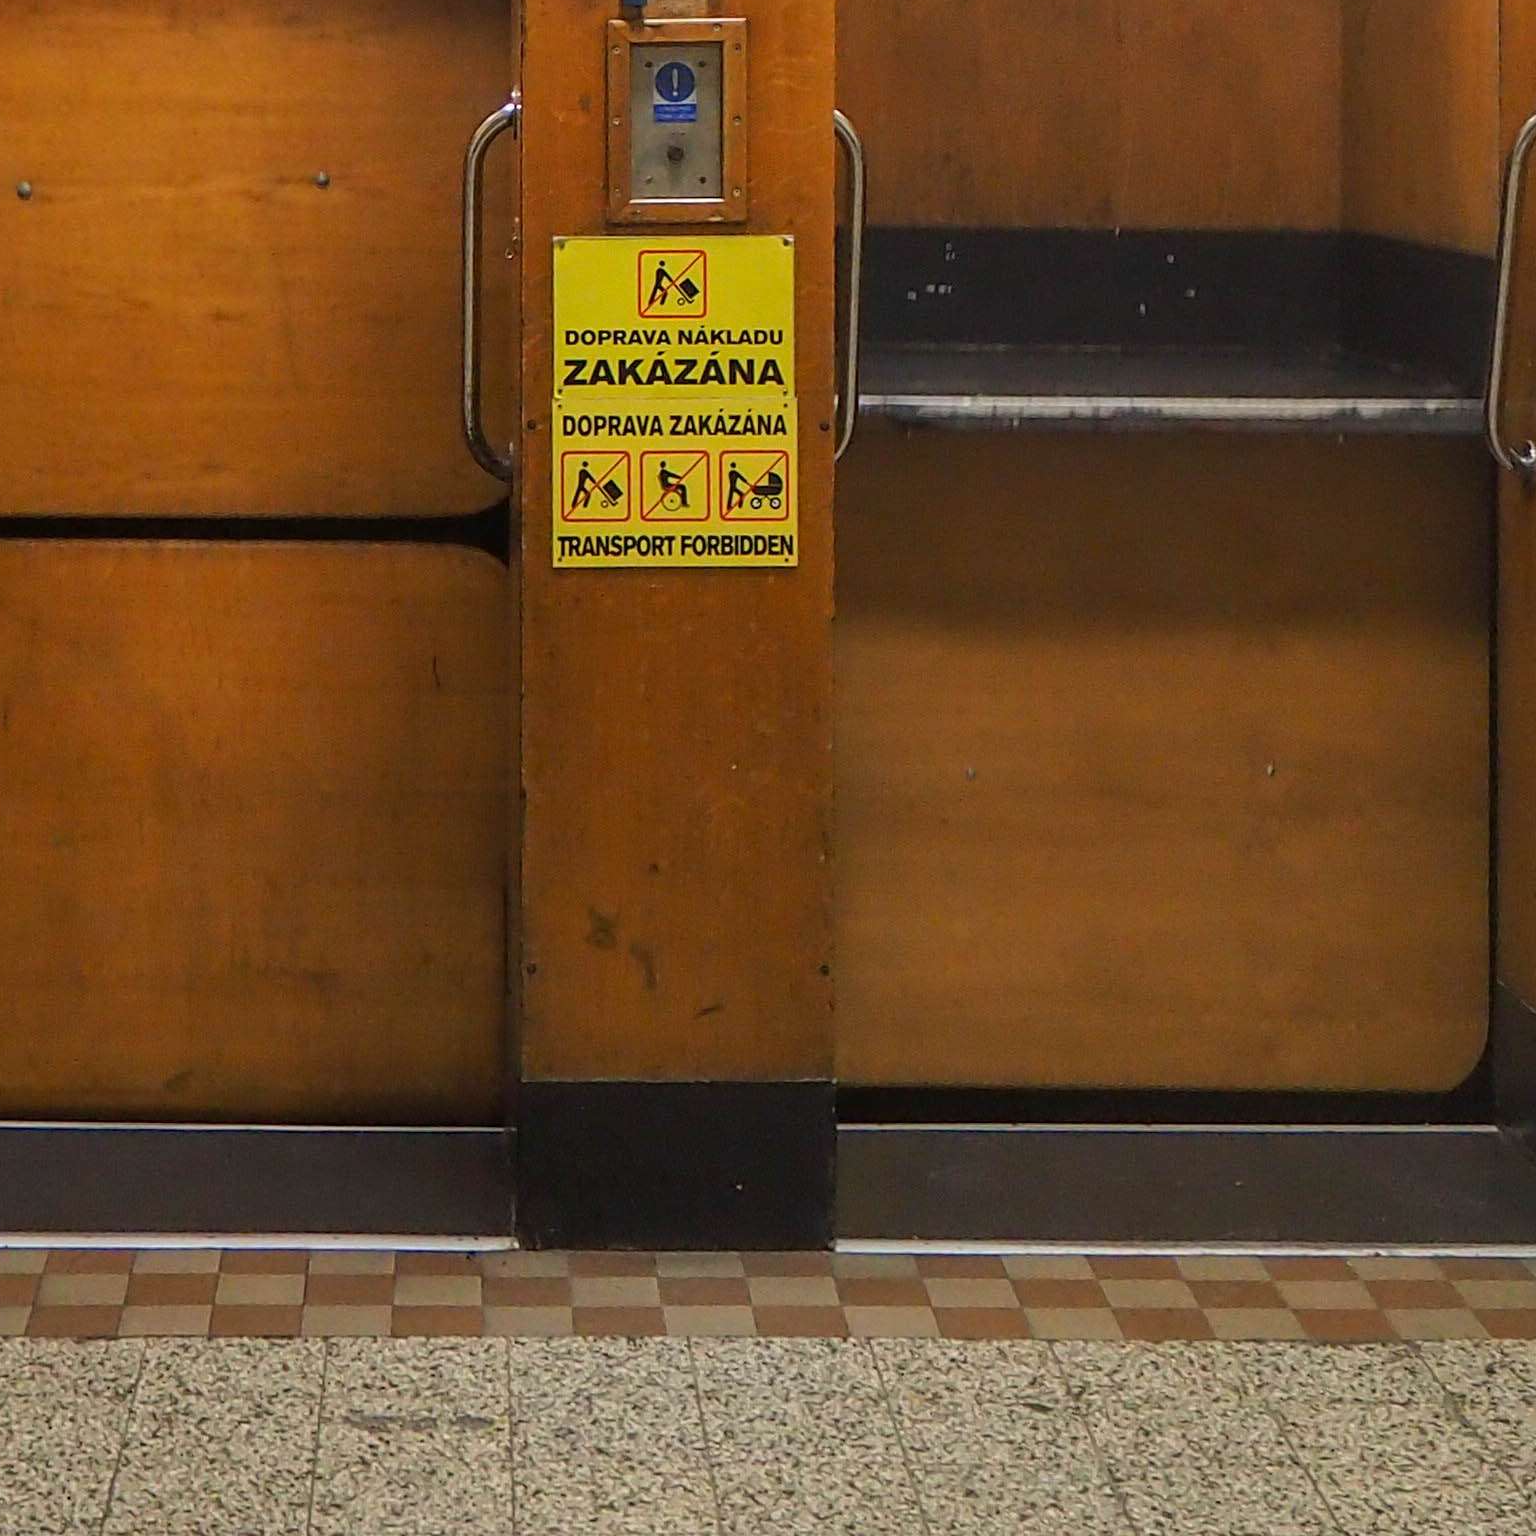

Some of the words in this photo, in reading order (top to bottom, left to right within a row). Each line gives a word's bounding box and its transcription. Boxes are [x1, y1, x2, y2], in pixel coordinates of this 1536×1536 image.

[565, 330, 671, 345] DOPRAVA
[678, 325, 783, 344] NÁKLADU
[563, 350, 785, 386] ZAKÁZÁNA
[563, 415, 663, 437] DOPRAVA
[669, 408, 787, 436] ZAKÁZÁNA
[558, 535, 676, 557] TRANSPORT
[680, 535, 794, 556] FORBIDDEN
